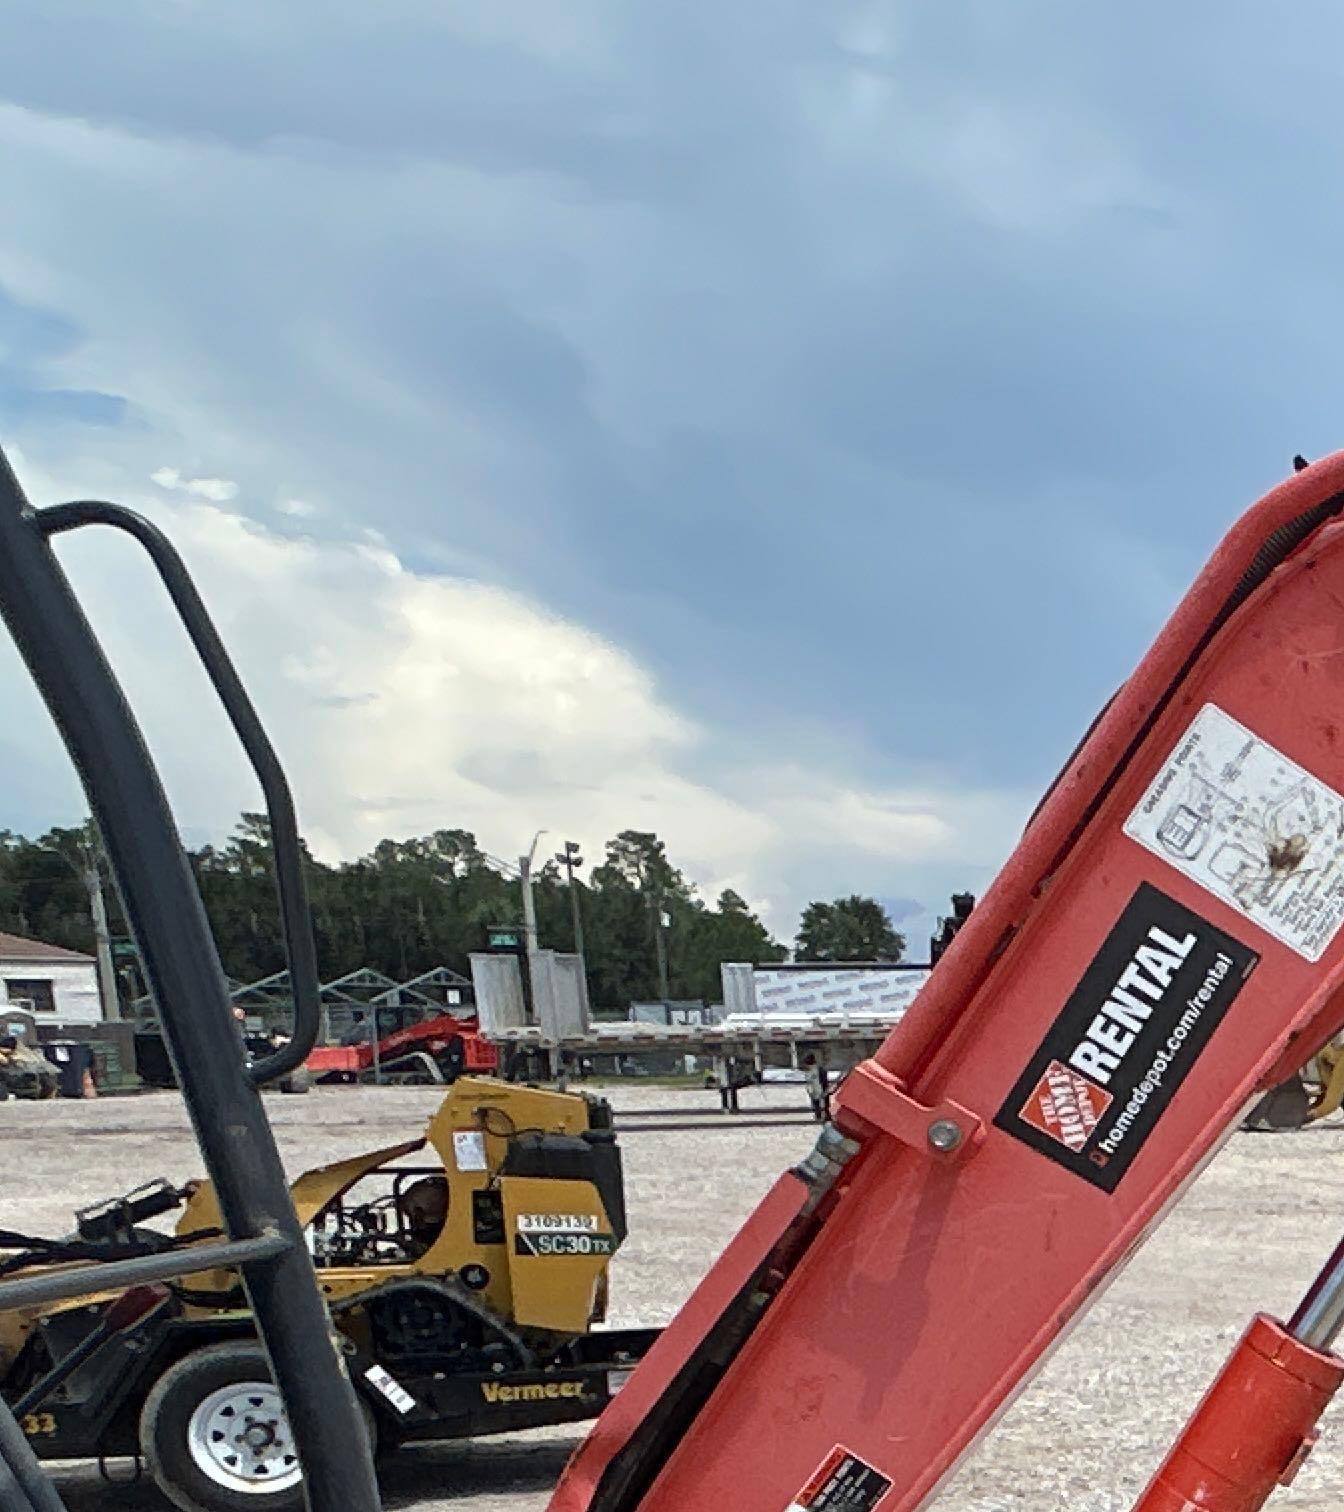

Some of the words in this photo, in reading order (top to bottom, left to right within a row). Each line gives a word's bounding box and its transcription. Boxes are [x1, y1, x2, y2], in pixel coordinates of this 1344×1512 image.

[1069, 926, 1197, 1085] RENTAL
[1098, 952, 1235, 1154] homedepot.com/rental
[1038, 1094, 1057, 1126] THE
[1047, 1070, 1087, 1145] HOME
[481, 1382, 584, 1402] Vermeer
